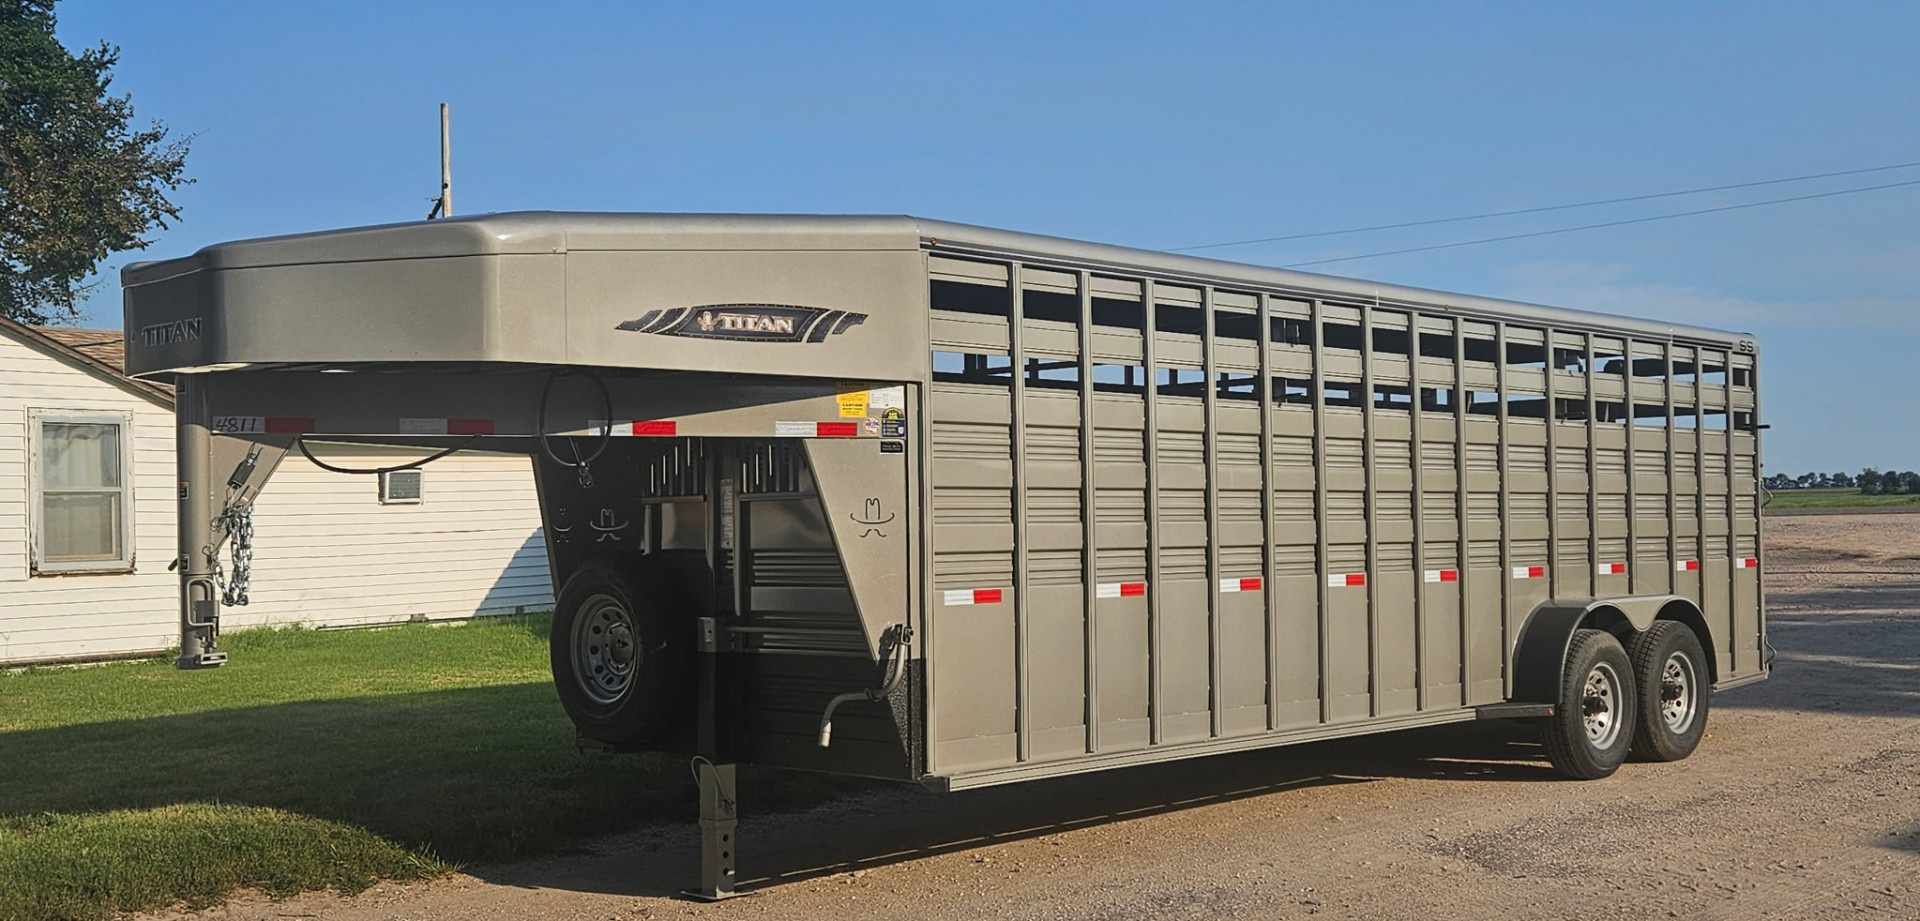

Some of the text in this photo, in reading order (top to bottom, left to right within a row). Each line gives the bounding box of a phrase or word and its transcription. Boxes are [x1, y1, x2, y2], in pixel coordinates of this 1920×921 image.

[719, 312, 794, 333] TITAN
[141, 317, 202, 347] TITAN
[1740, 340, 1754, 353] SS
[216, 417, 257, 432] 4811
